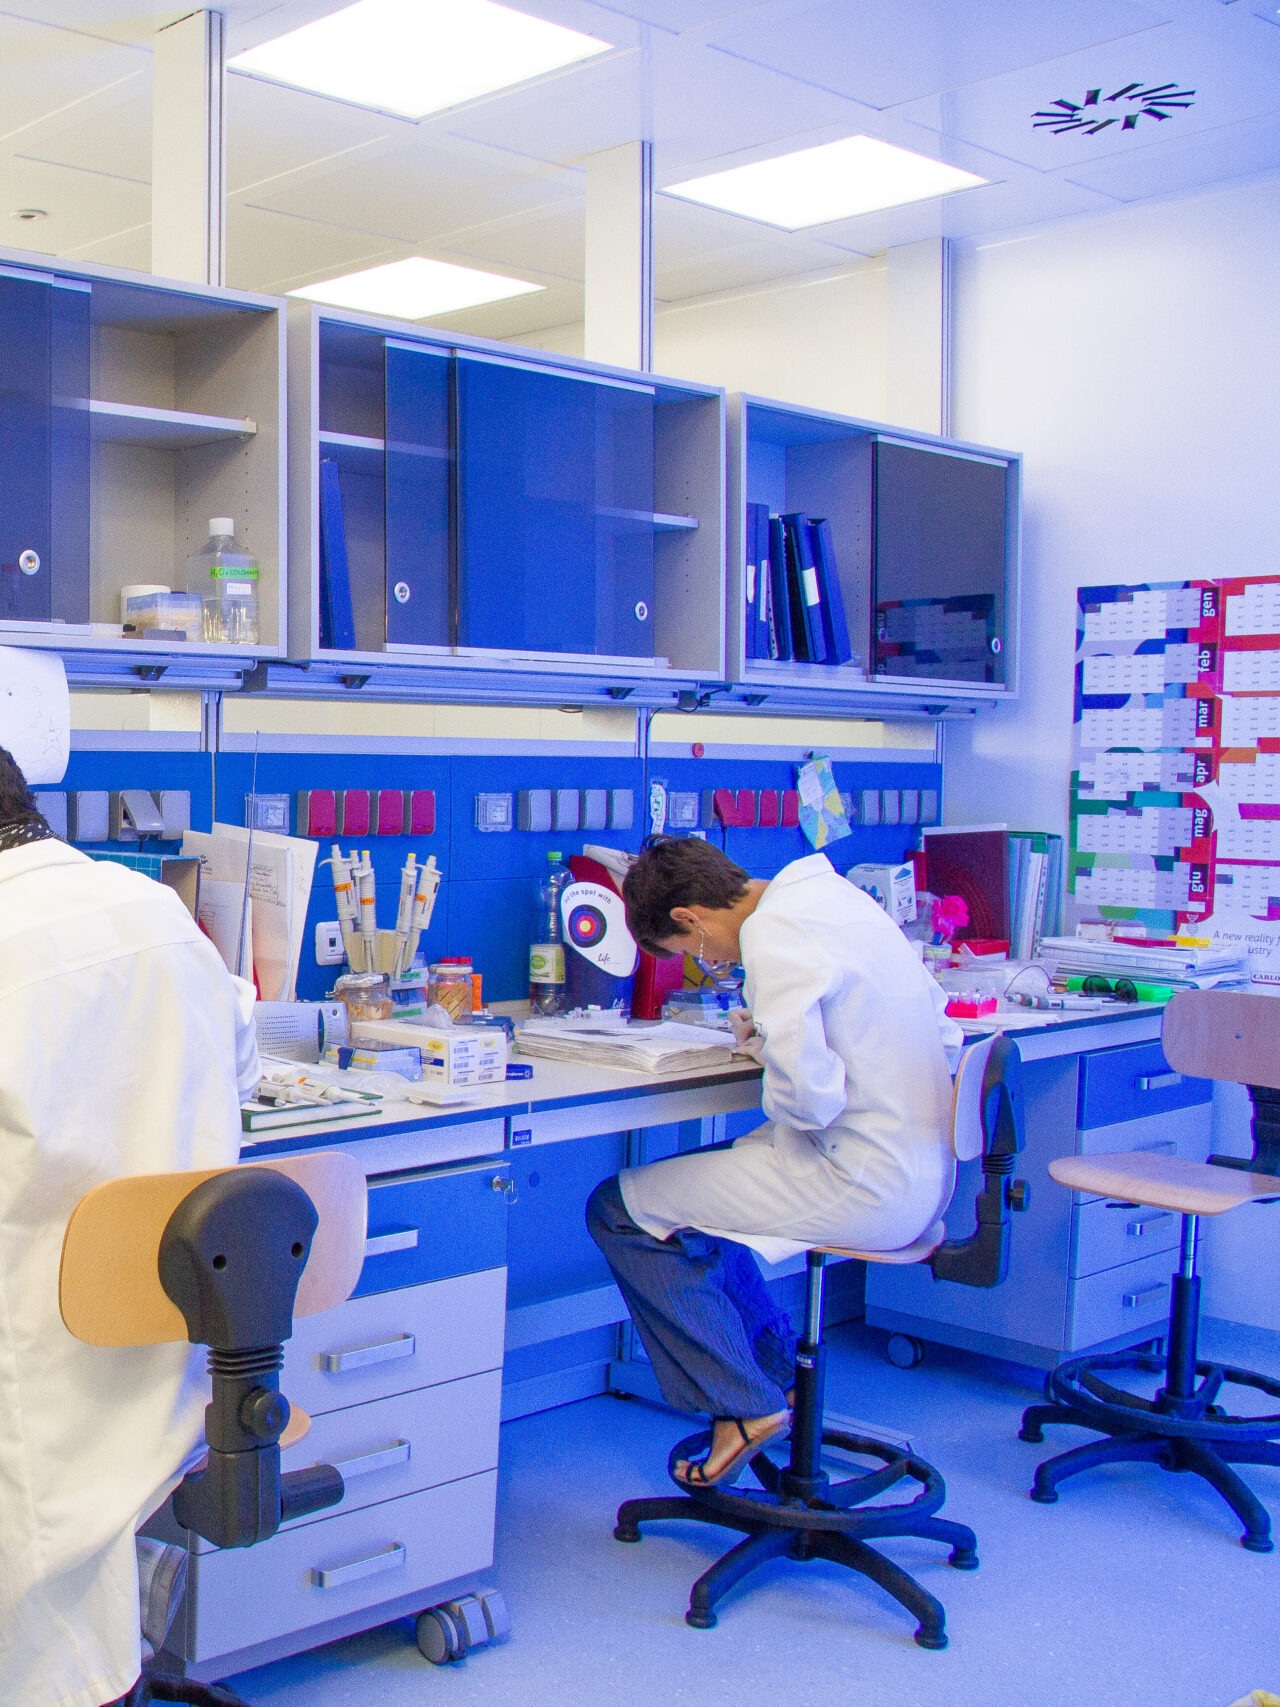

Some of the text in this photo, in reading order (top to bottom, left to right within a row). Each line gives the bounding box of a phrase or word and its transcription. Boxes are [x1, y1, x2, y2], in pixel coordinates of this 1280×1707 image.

[1202, 591, 1216, 617] gen
[1198, 650, 1210, 672] feb
[1198, 701, 1208, 728] mar
[1195, 760, 1208, 784] apr
[1193, 808, 1209, 838] mag
[1189, 871, 1204, 893] giu
[598, 893, 612, 905] with
[1212, 930, 1220, 940] A
[1222, 933, 1242, 941] new
[1245, 934, 1275, 946] reality
